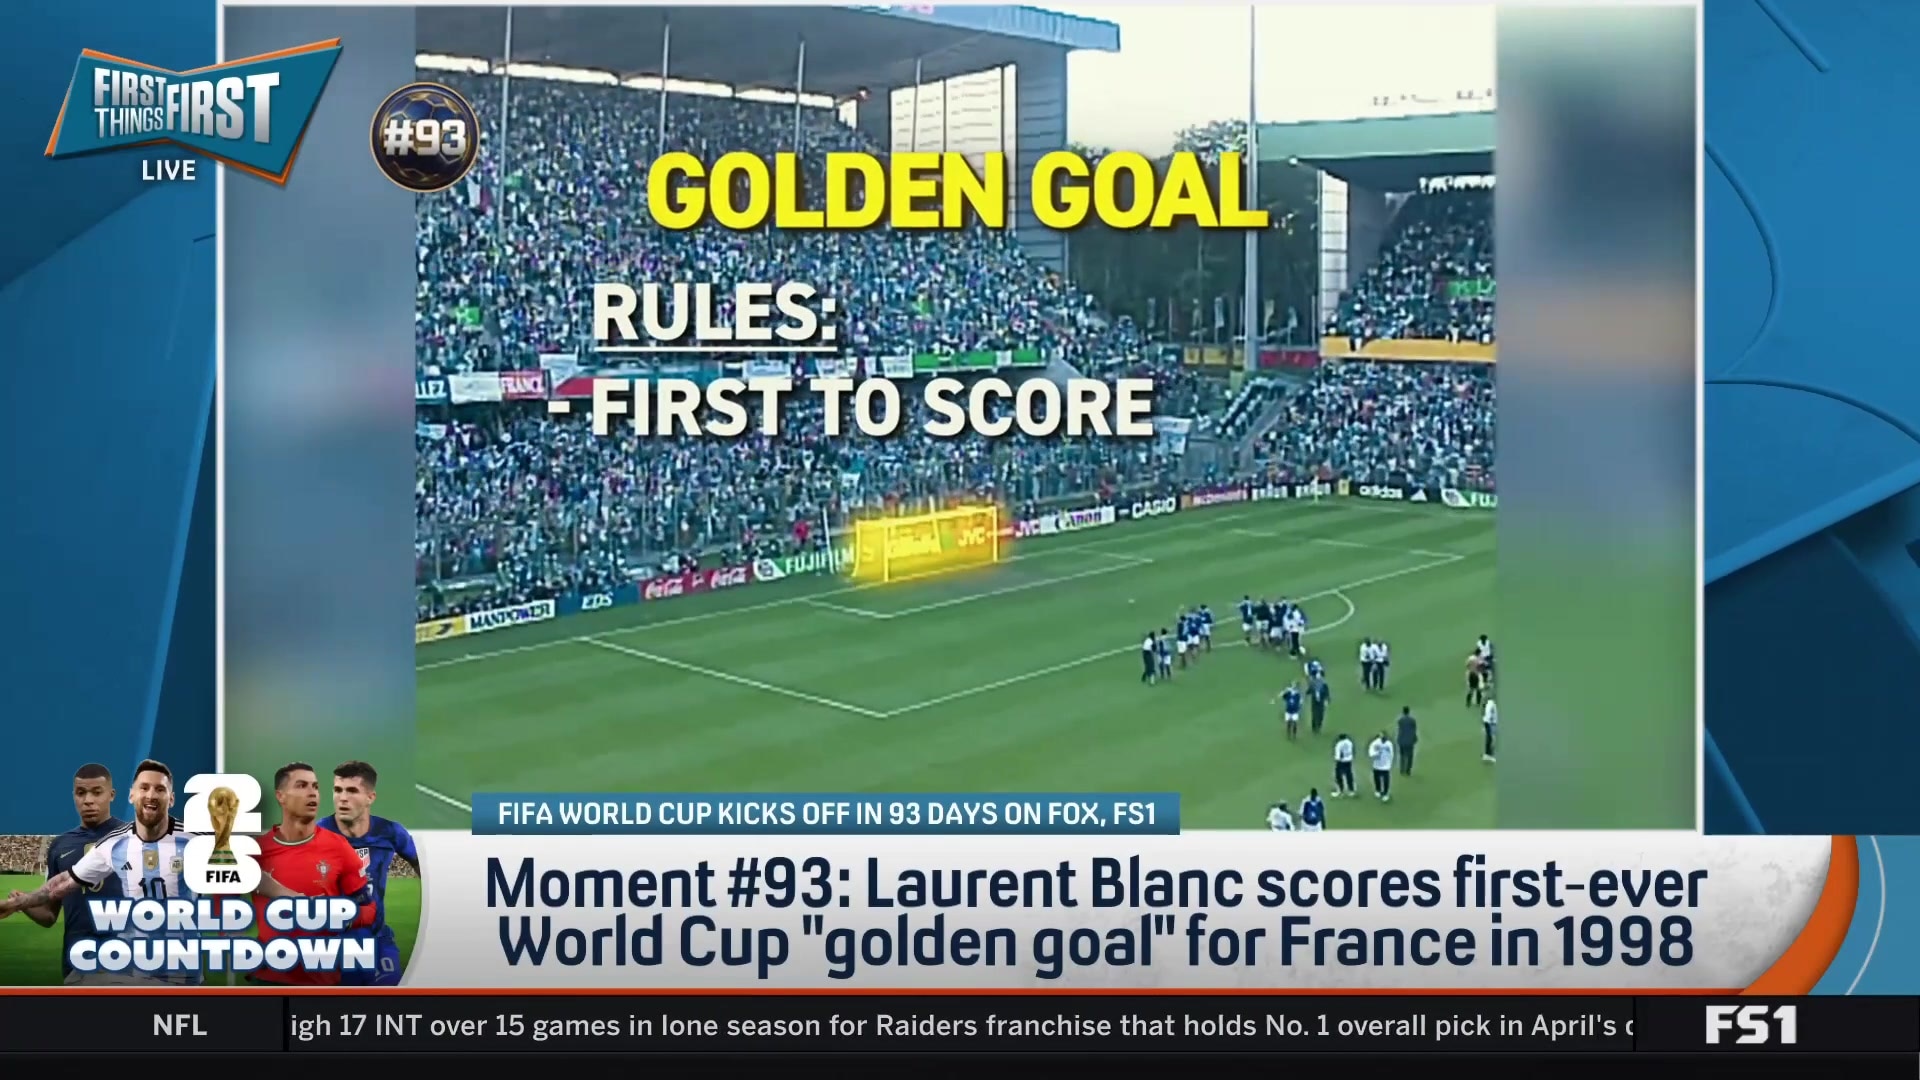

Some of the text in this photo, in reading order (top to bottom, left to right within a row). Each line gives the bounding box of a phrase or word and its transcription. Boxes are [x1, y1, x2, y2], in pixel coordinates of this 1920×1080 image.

[1359, 485, 1403, 499] adidas
[1132, 496, 1177, 519] CASIO
[958, 526, 986, 547] JVC
[1015, 520, 1040, 537] JVC
